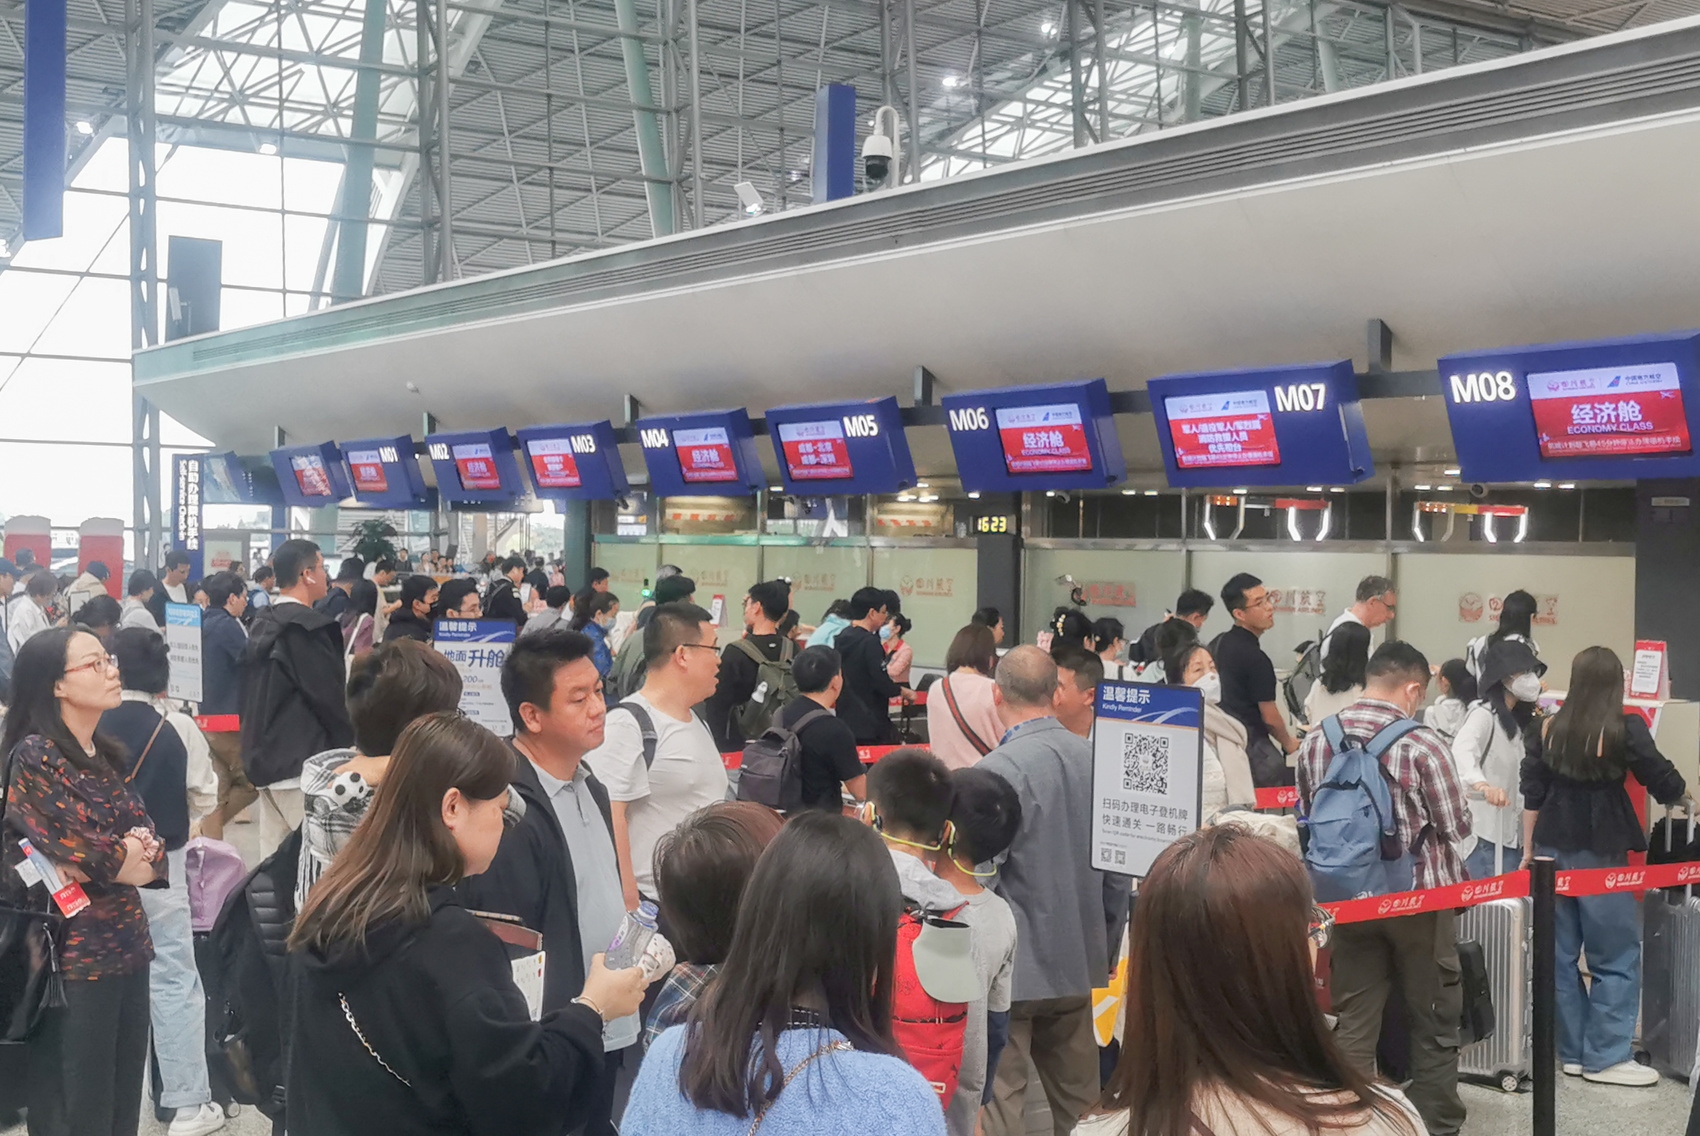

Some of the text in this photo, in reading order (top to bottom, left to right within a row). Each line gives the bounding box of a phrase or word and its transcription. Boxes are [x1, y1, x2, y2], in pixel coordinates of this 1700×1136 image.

[1450, 371, 1516, 403] M08
[1274, 383, 1326, 412] M07
[949, 407, 989, 431] M06
[1571, 400, 1643, 424] 经济舱
[843, 415, 879, 437] M05
[1567, 421, 1654, 435] ECONOMY CLASS
[570, 434, 596, 453] M03
[640, 428, 669, 448] M04
[1023, 431, 1064, 448] 经济舱
[379, 446, 399, 463] M01
[429, 443, 450, 460] M02
[439, 621, 477, 632] 温馨提示
[1102, 685, 1151, 704] 温馨提示
[1102, 703, 1142, 713] Kindly Reminder
[1102, 797, 1188, 820] 扫码办理电子登机牌
[1102, 813, 1142, 831] 快速通关
